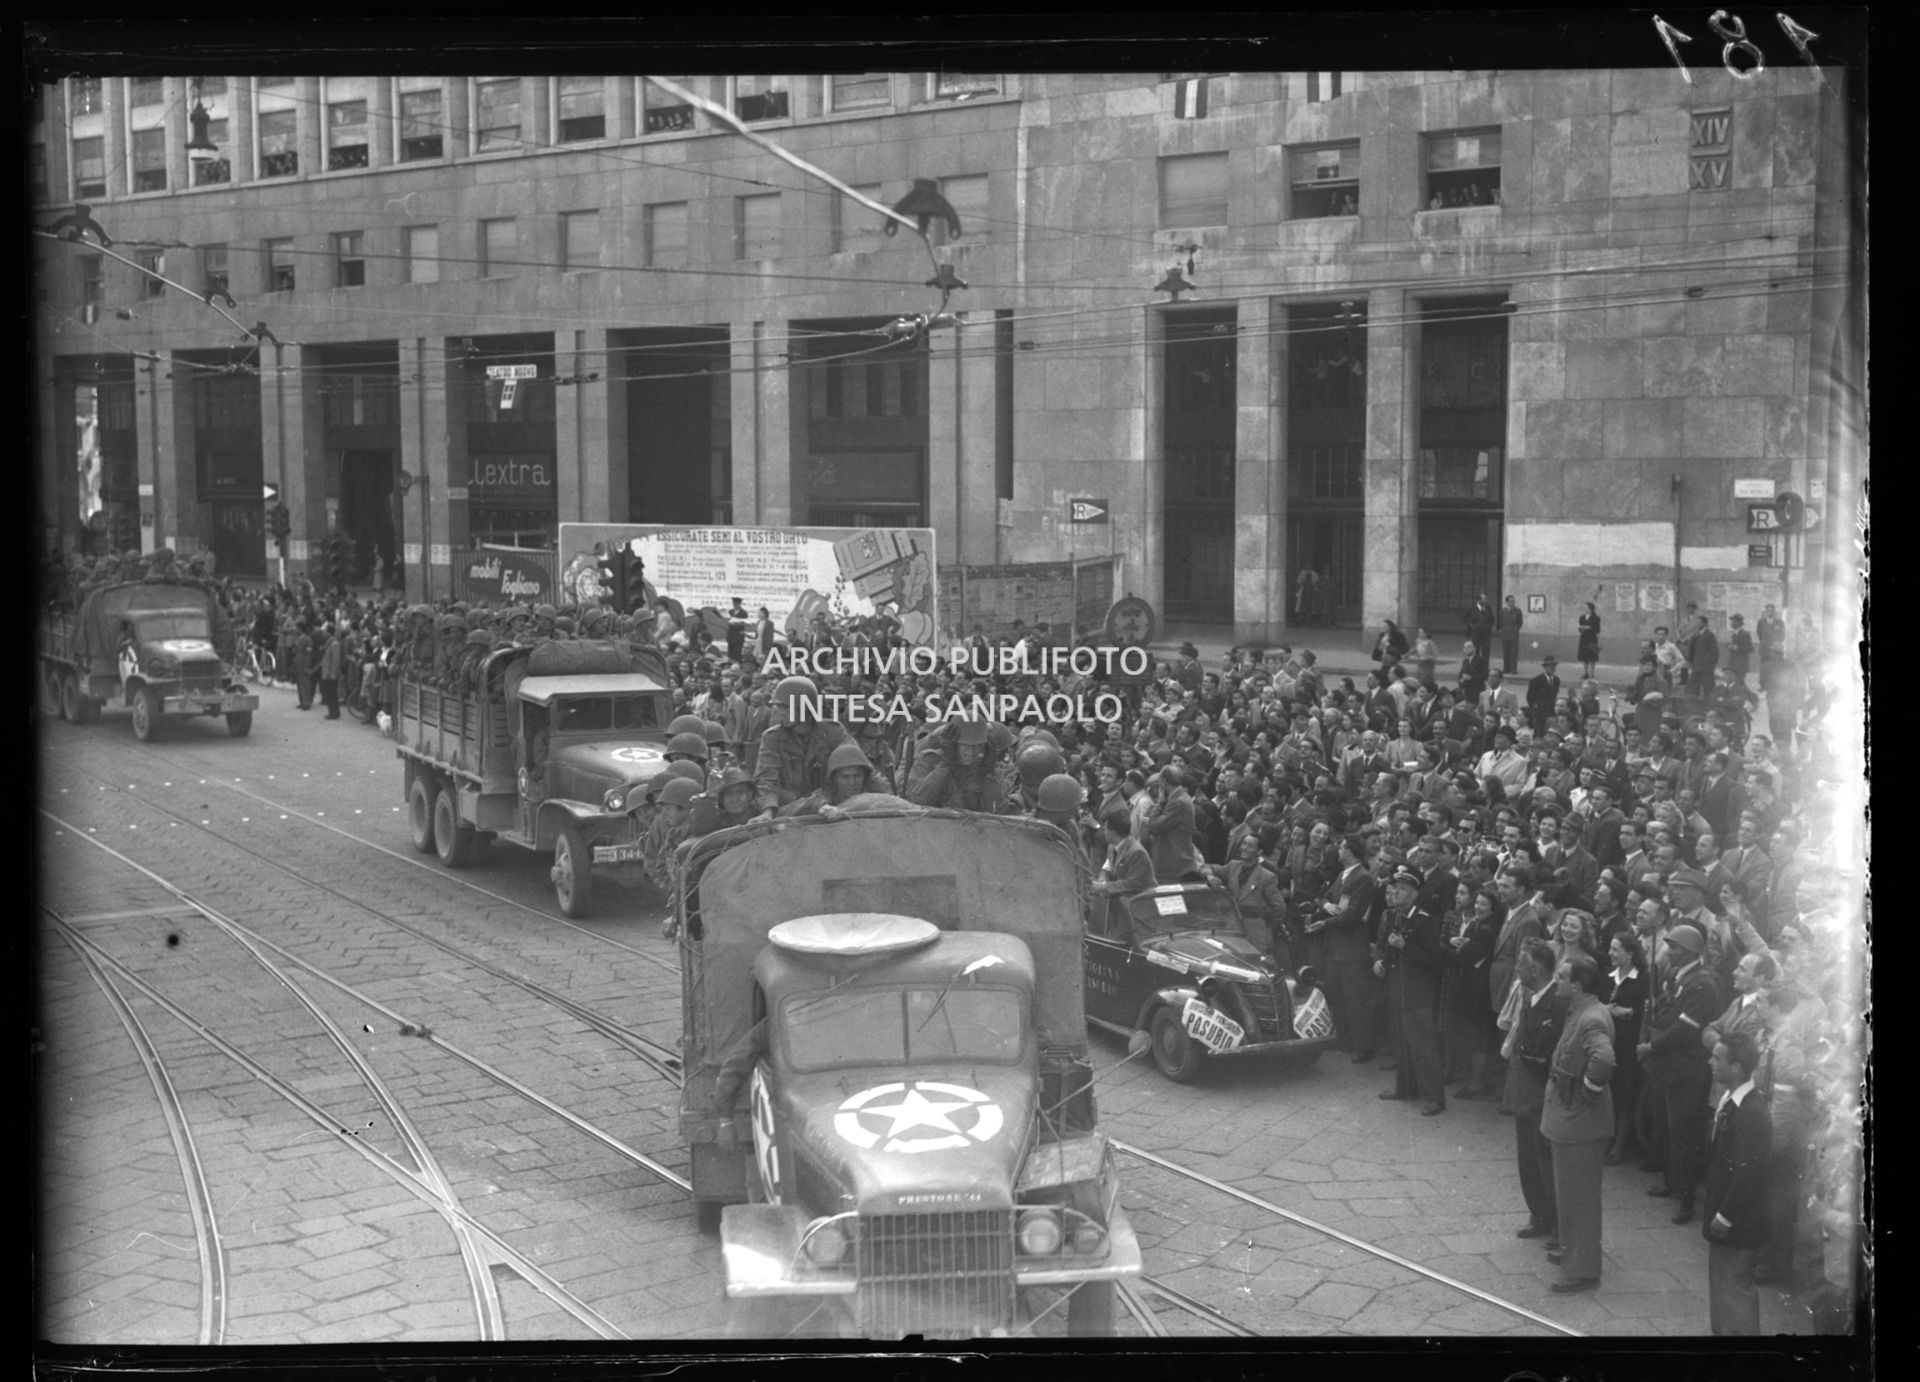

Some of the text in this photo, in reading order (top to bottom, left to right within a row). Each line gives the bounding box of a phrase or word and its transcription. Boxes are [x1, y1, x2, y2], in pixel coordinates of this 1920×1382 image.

[1691, 118, 1729, 146] XIV
[1691, 160, 1728, 188] XV
[468, 459, 551, 488] lextra
[1756, 510, 1770, 527] R
[711, 530, 731, 542] SEMI
[733, 531, 744, 543] AL
[746, 531, 781, 544] VOSTRO
[783, 532, 808, 544] ORTO
[470, 557, 502, 579] mobili
[501, 569, 540, 601] Fogliano
[1186, 1012, 1234, 1050] PASUBIO
